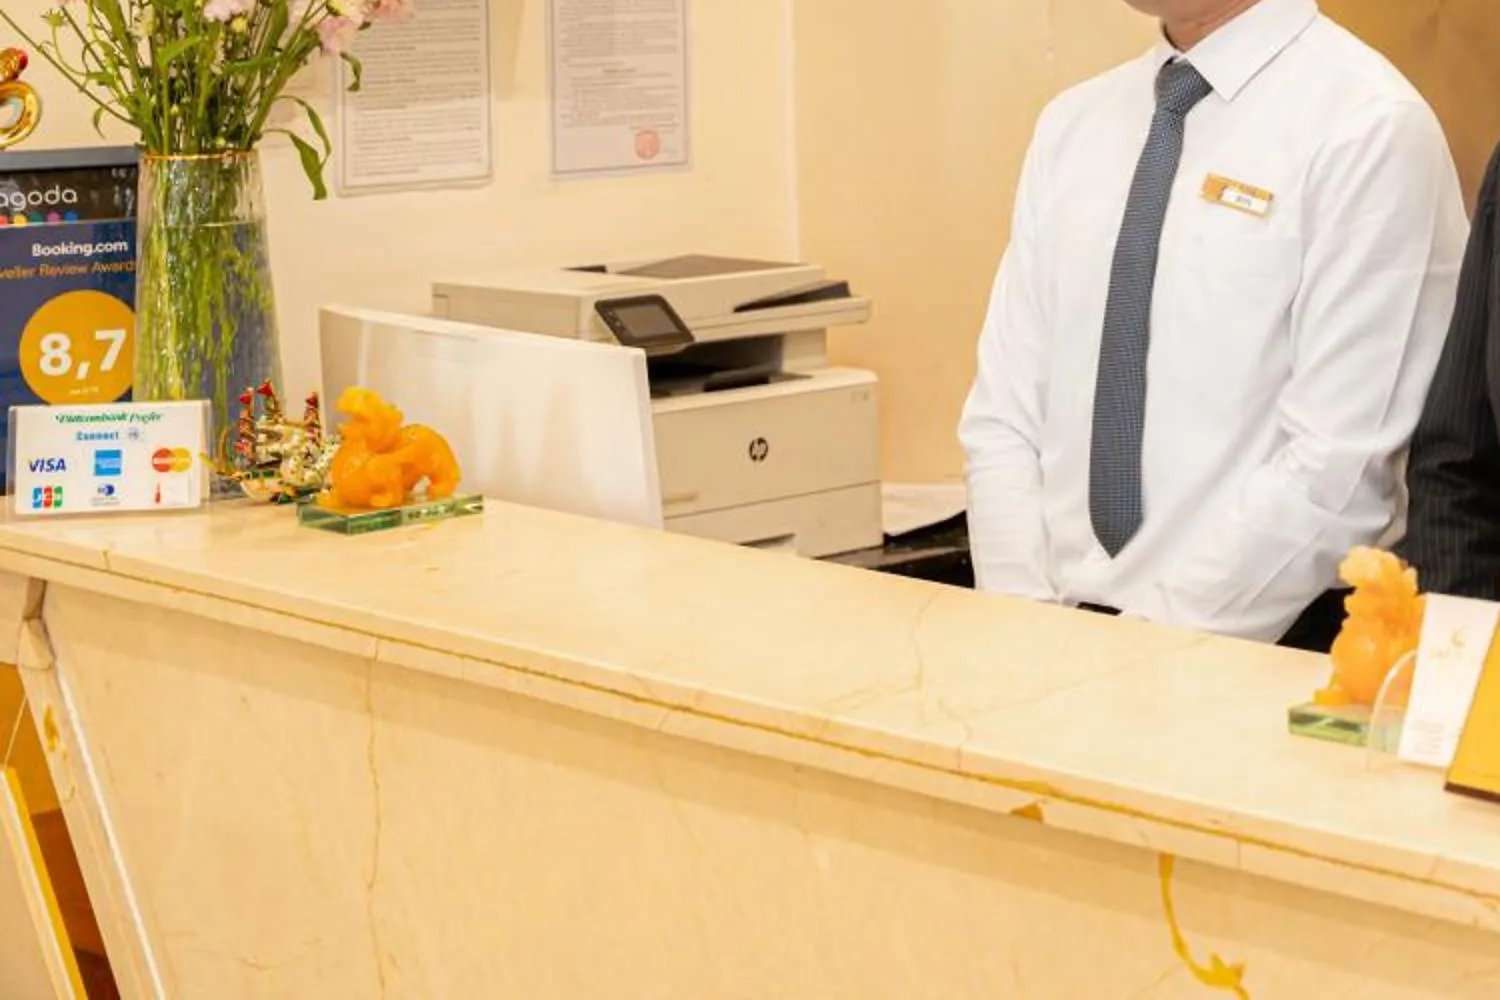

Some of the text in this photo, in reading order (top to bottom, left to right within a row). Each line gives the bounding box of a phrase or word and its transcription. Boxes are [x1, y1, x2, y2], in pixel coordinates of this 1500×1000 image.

[31, 241, 129, 257] Booking.com
[38, 329, 127, 381] 8,7
[29, 457, 67, 473] VISA
